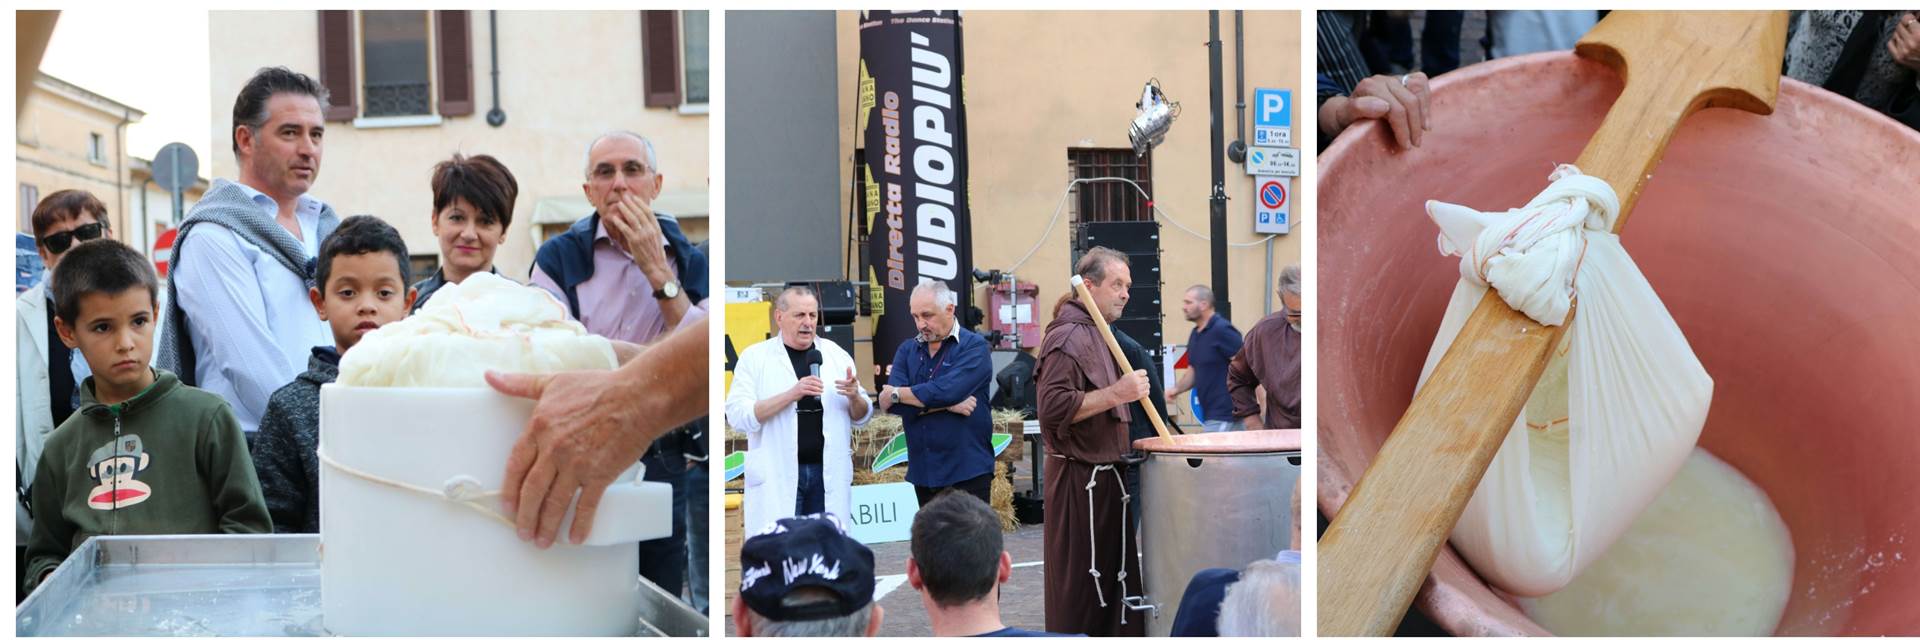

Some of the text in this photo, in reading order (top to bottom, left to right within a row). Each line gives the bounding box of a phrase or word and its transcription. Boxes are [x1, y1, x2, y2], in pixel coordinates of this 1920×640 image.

[1263, 93, 1284, 122] P
[782, 556, 808, 586] New
[808, 553, 840, 580] York
